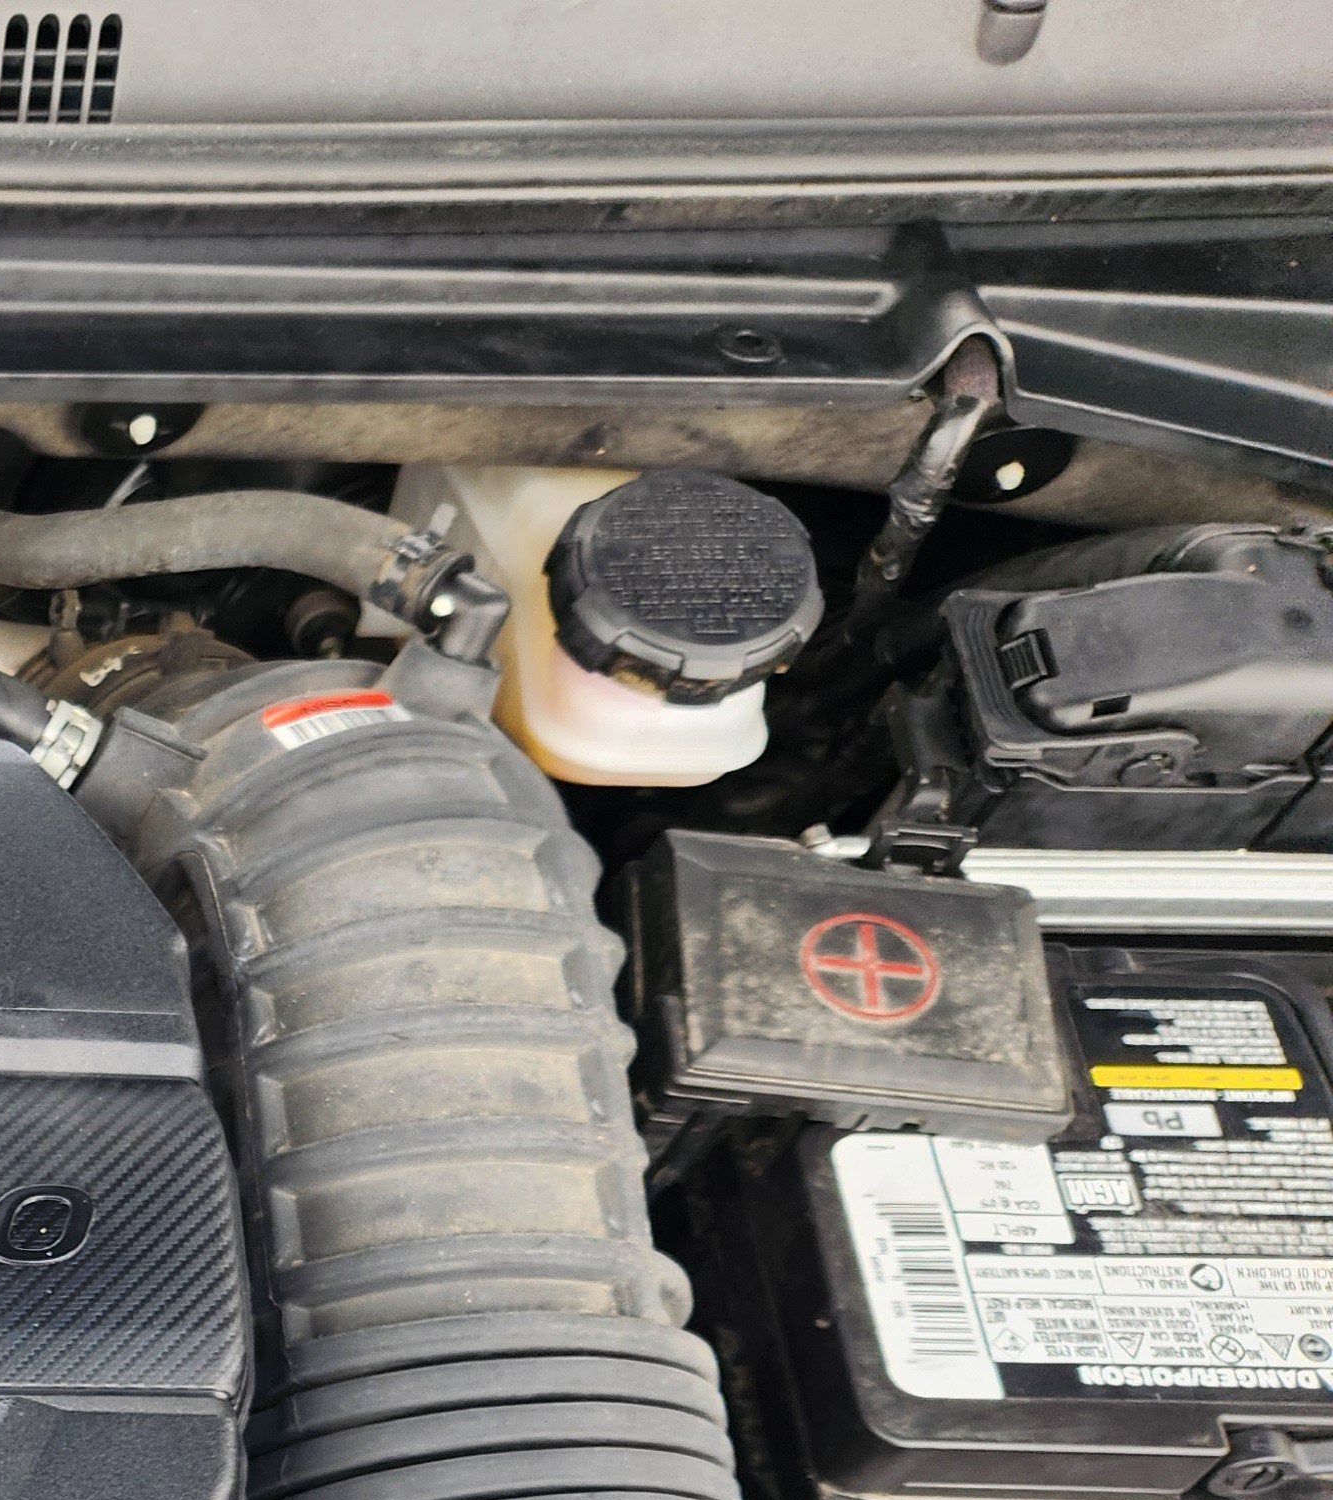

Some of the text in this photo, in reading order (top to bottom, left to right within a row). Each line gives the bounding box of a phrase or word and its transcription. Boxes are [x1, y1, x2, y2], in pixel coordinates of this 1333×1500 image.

[1141, 1111, 1184, 1131] Pb
[1064, 1179, 1130, 1206] AGM
[1076, 1366, 1321, 1389] DANGER/POISON
